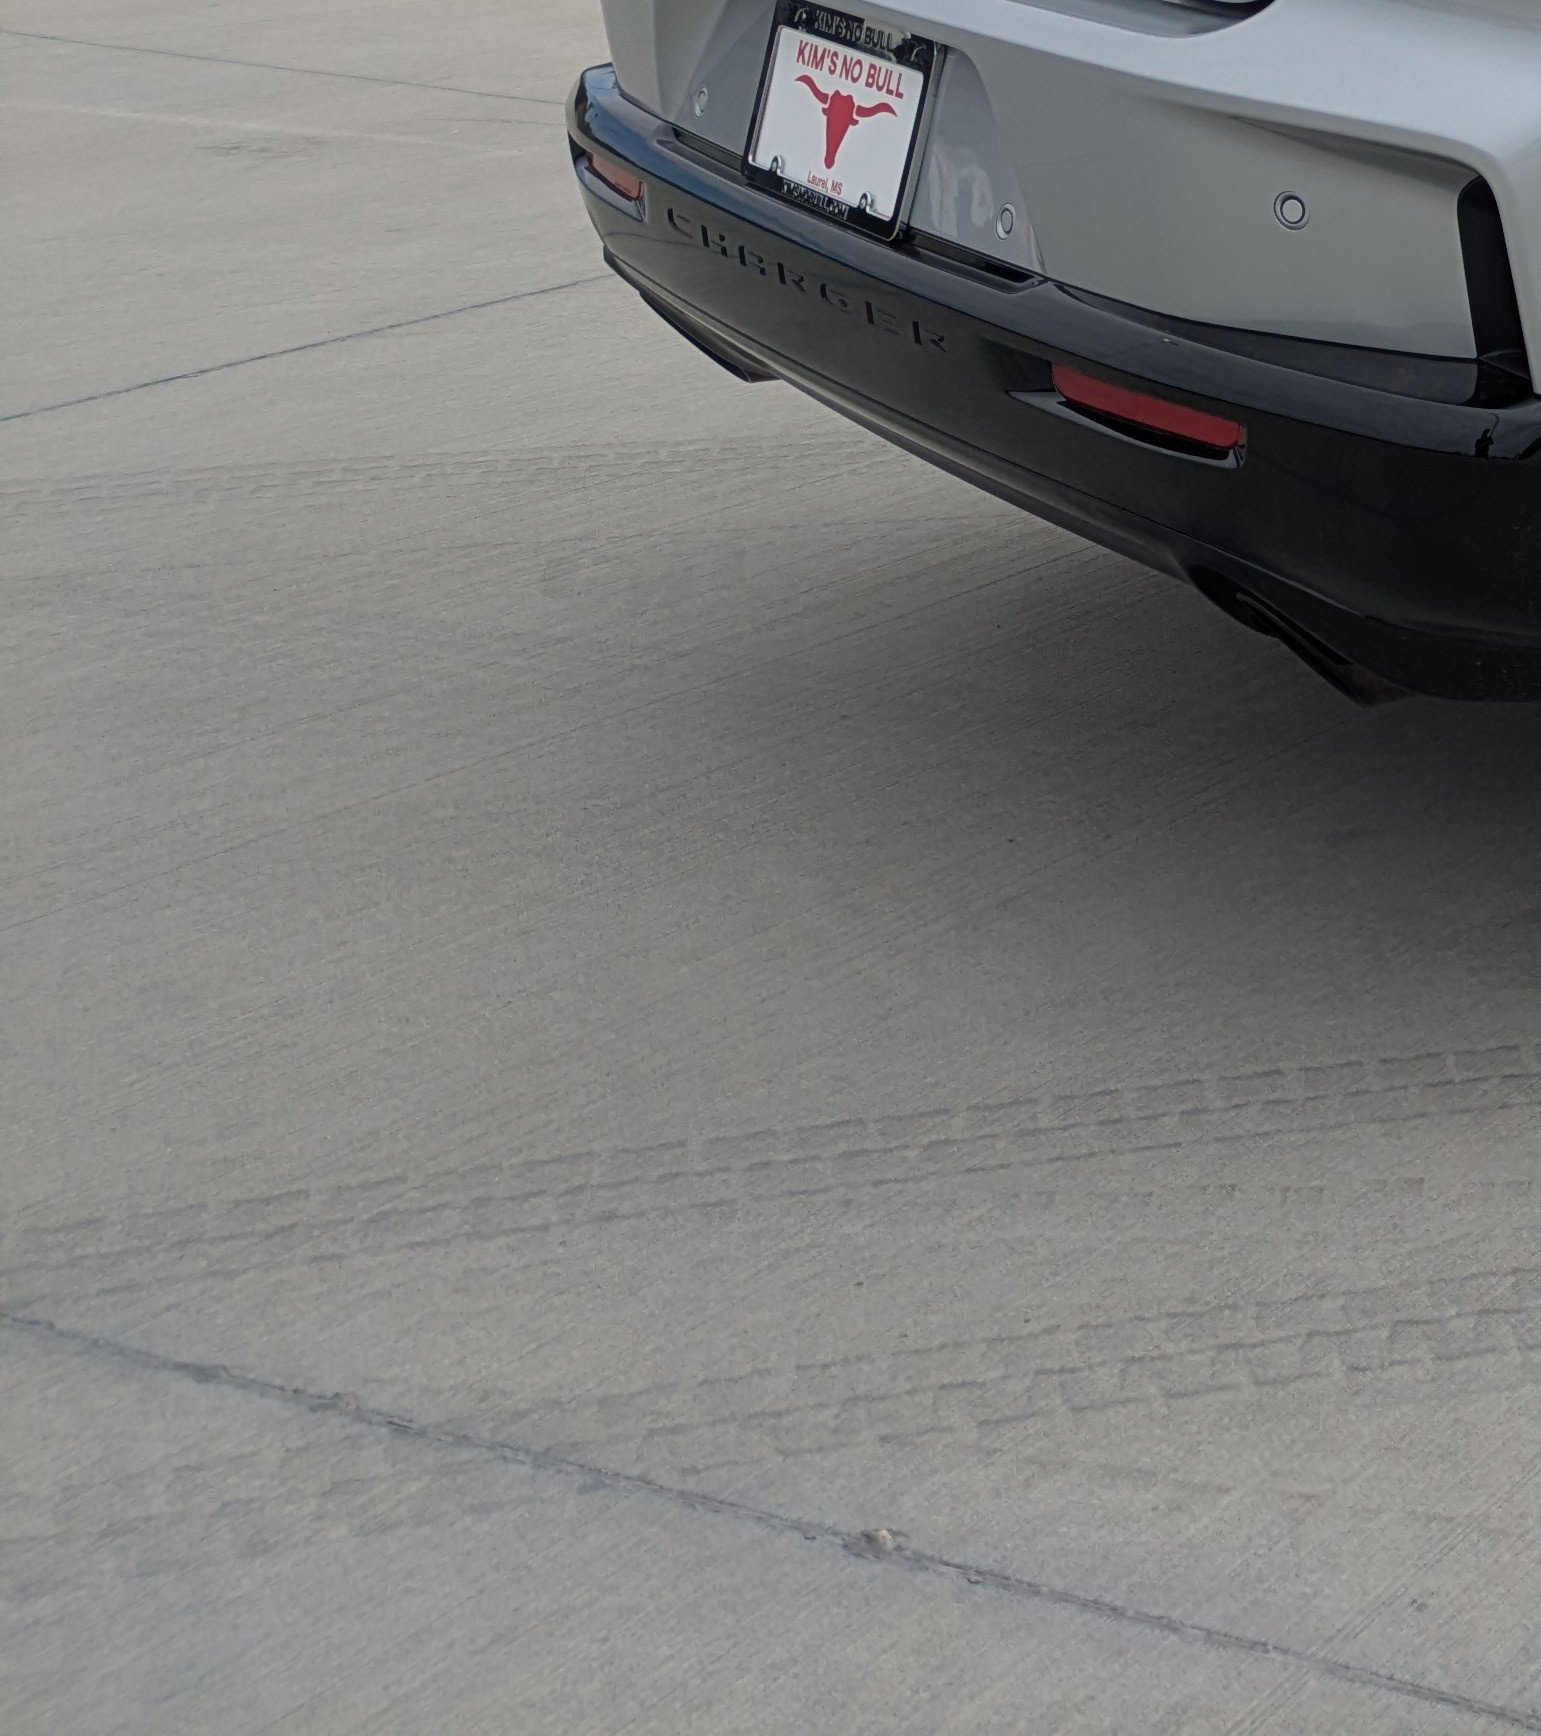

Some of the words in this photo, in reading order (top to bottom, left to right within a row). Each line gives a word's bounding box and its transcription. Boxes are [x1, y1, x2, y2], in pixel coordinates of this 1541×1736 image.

[796, 40, 840, 76] KIM'S
[839, 56, 864, 84] NO
[864, 63, 905, 100] BULL
[830, 179, 843, 196] MS
[667, 207, 947, 353] CHARGER
